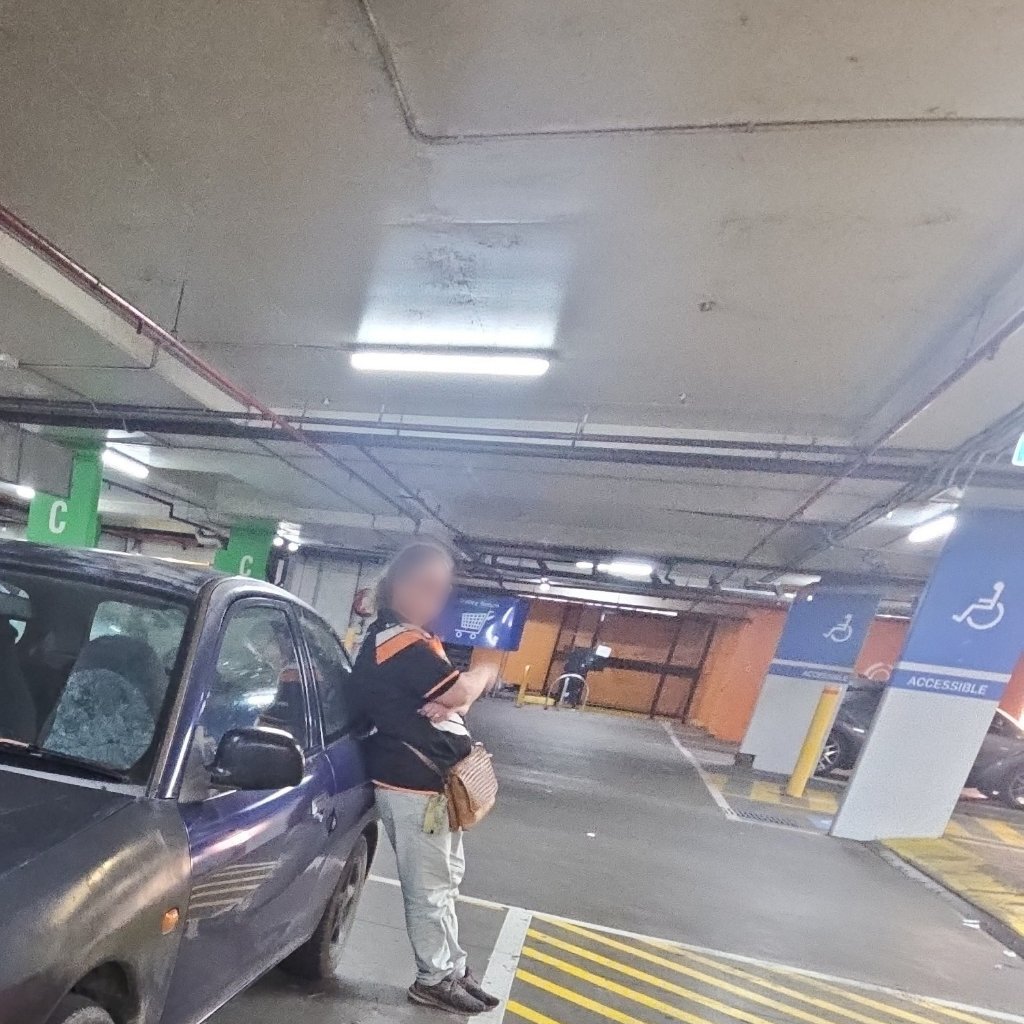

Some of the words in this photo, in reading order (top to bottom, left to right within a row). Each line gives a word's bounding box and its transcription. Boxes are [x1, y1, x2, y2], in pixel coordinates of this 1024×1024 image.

[49, 500, 67, 533] C
[240, 555, 254, 576] C
[907, 676, 988, 695] ACCESSIBLE
